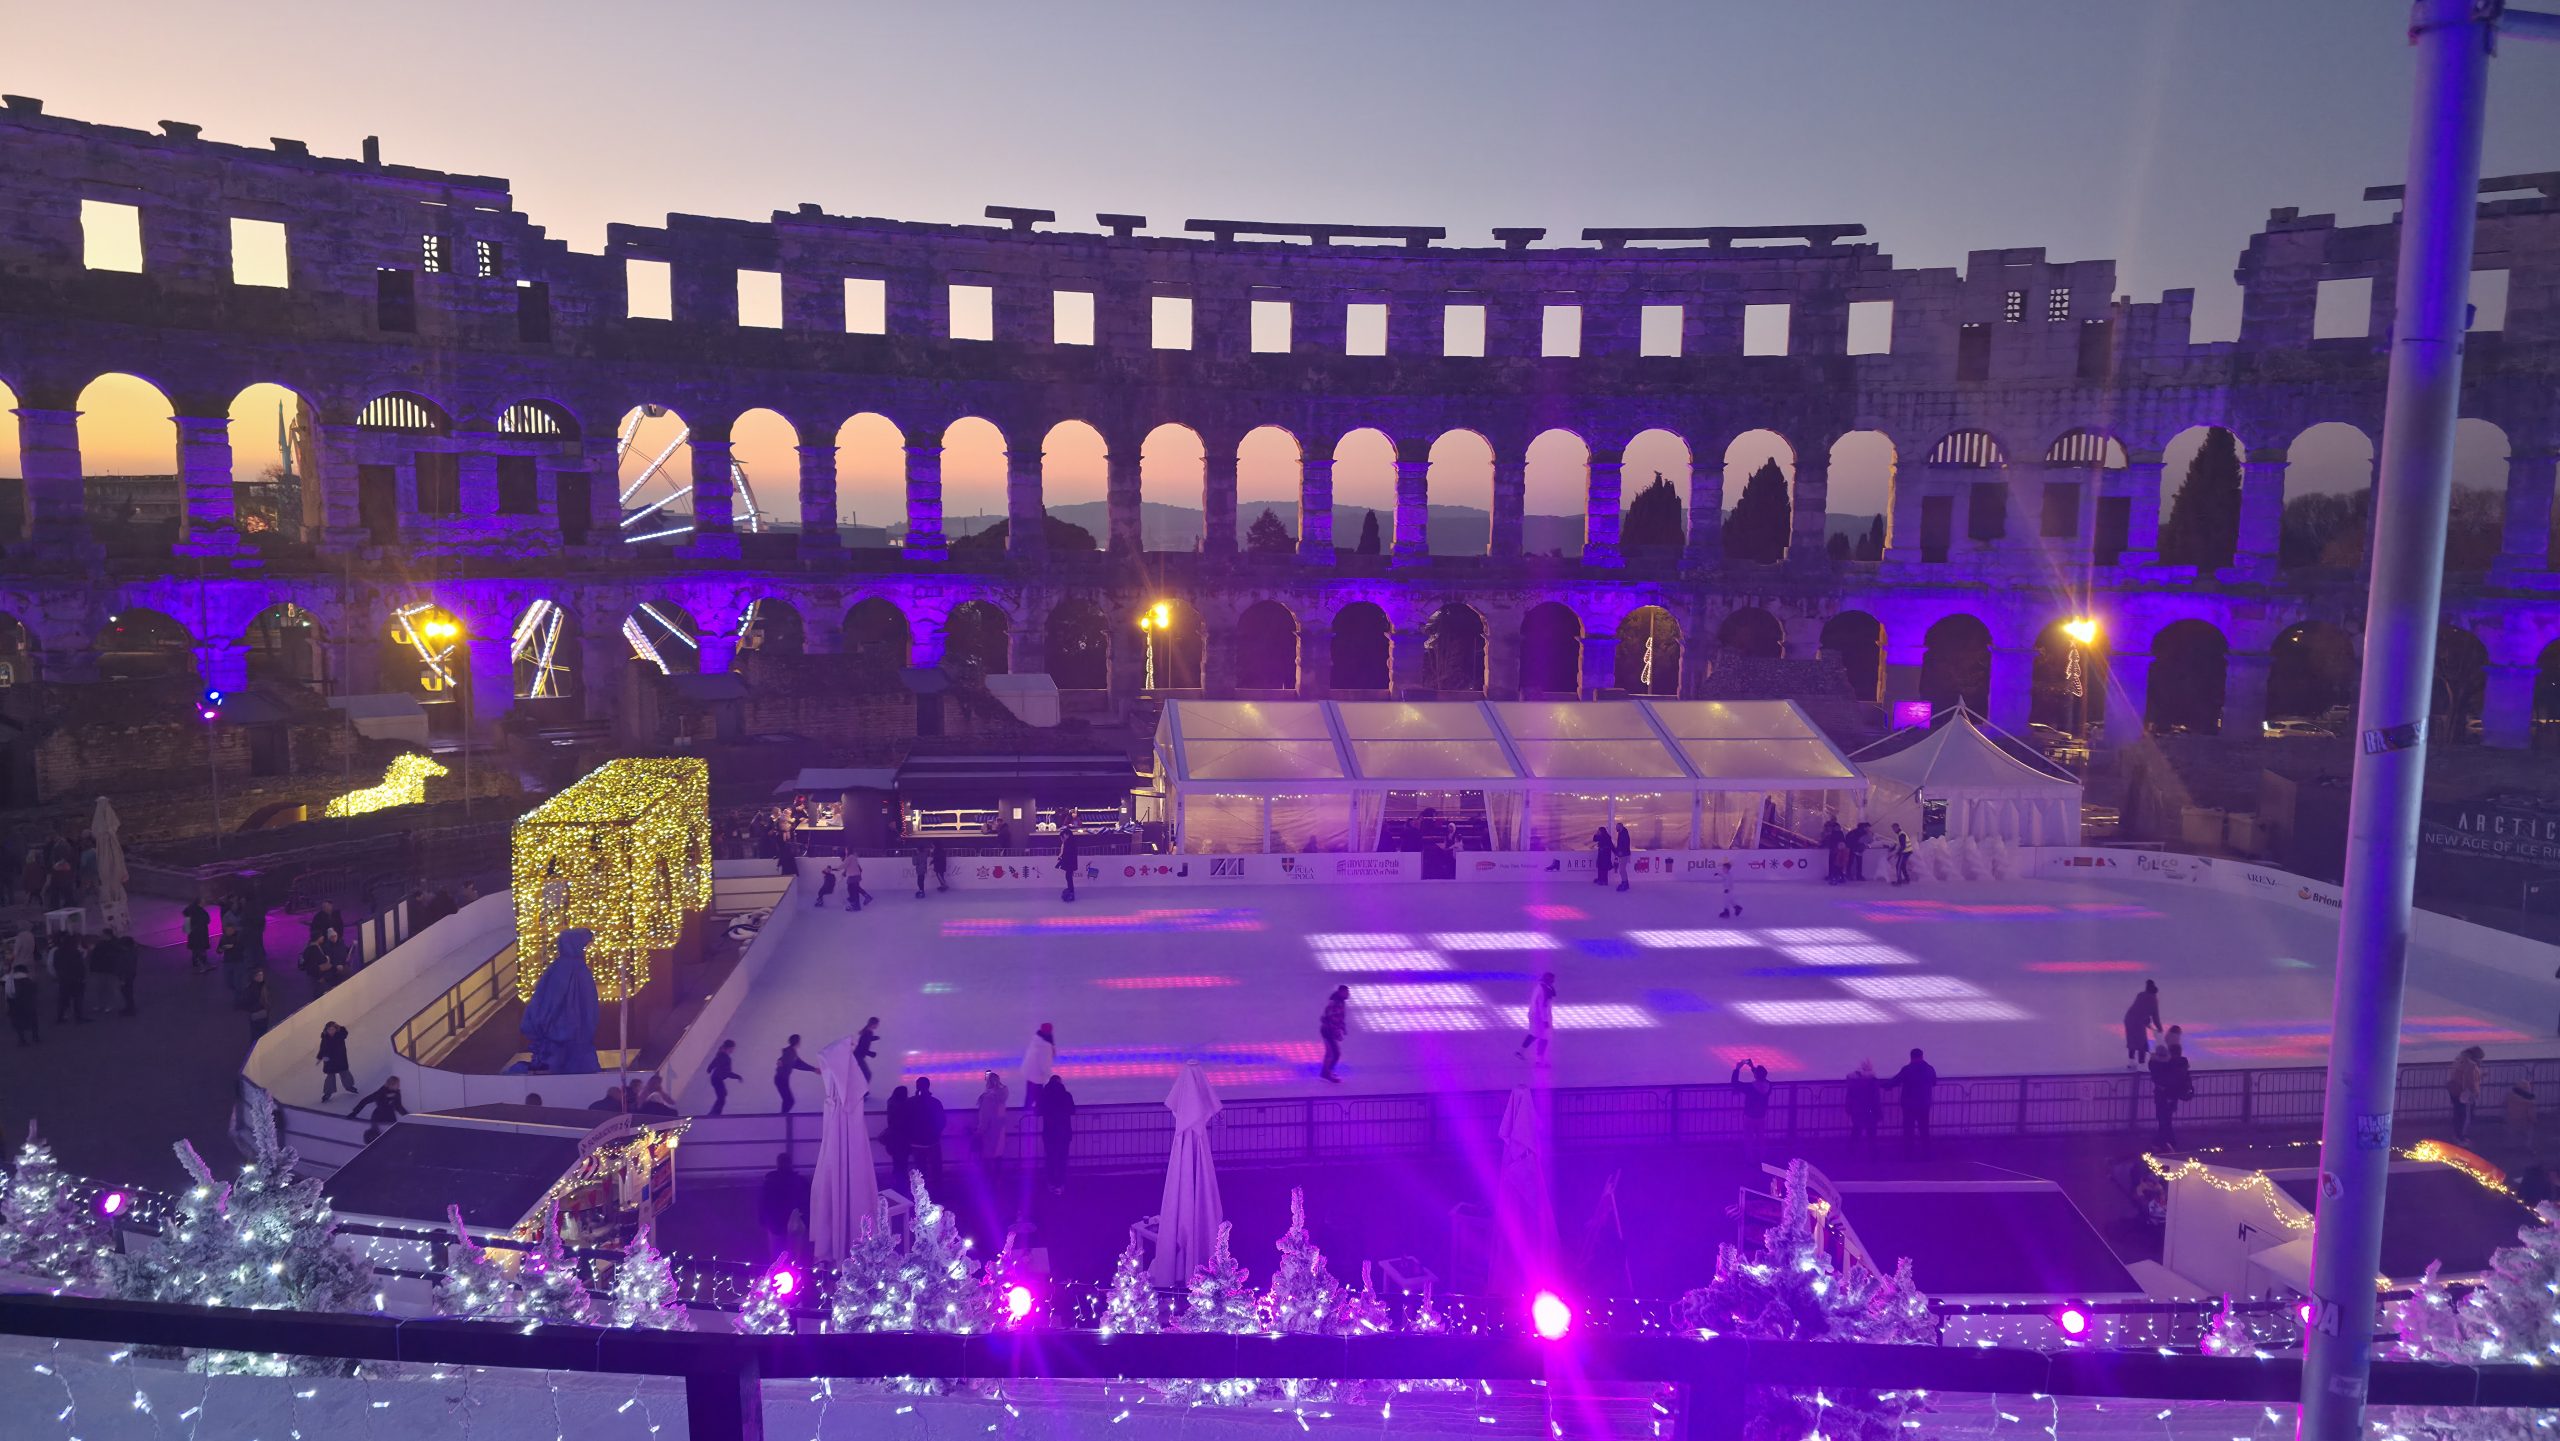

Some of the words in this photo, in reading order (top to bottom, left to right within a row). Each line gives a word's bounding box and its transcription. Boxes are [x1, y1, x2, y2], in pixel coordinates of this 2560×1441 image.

[2458, 812, 2556, 840] ARCTIC
[2425, 832, 2459, 846] NEW
[2461, 838, 2490, 850] AGE
[2494, 840, 2513, 852] OF
[2516, 843, 2538, 857] ICE
[1567, 859, 1594, 869] ARCT
[1687, 858, 1716, 872] pula
